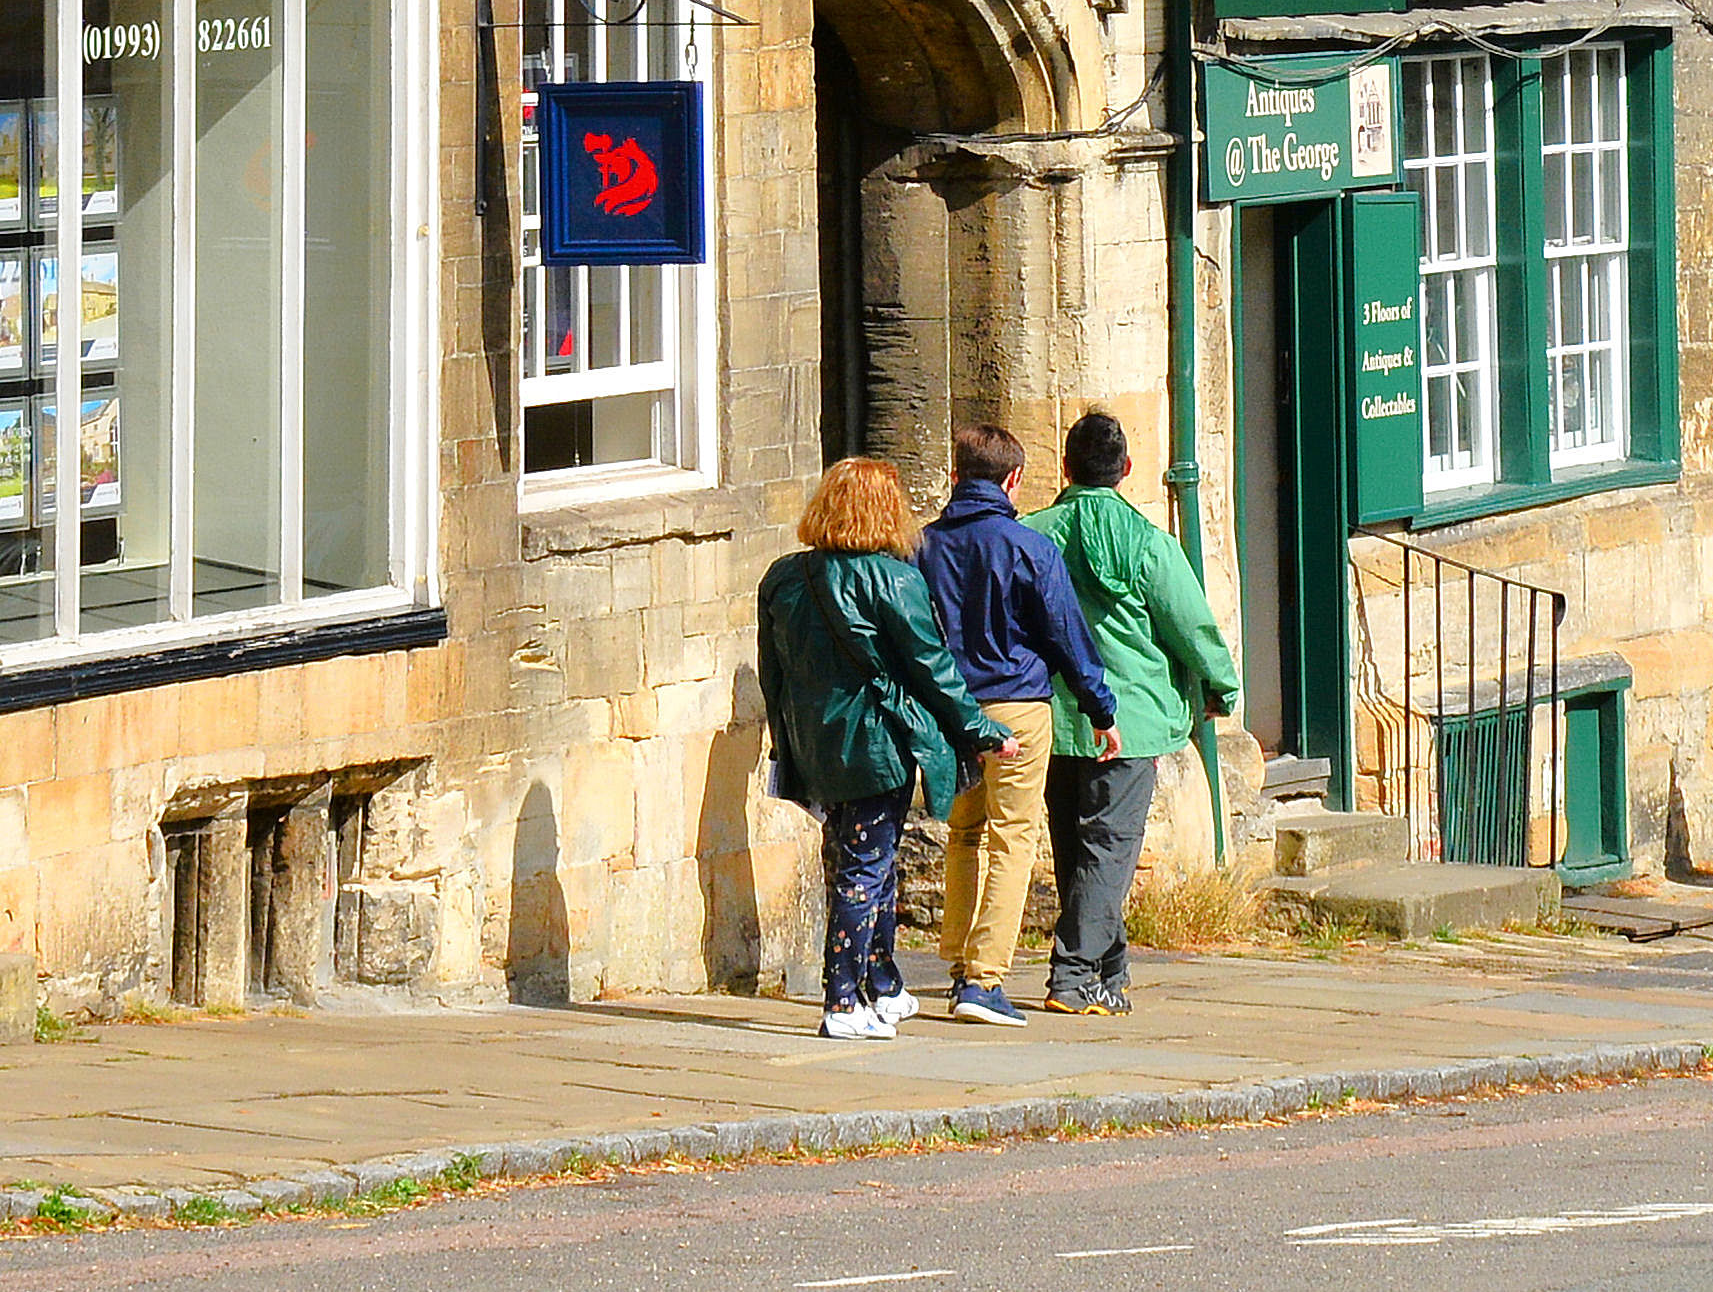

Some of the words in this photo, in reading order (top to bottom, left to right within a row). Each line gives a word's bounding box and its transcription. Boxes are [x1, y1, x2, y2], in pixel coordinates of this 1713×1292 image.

[83, 20, 161, 64] (01993)
[198, 16, 272, 52] 822661
[1245, 79, 1315, 127] Antiques
[1225, 137, 1245, 187] @
[1247, 134, 1281, 174] The
[1283, 132, 1339, 181] George
[1363, 303, 1369, 325] 3
[1372, 300, 1400, 323] Floors
[1401, 297, 1412, 320] of
[1362, 349, 1402, 376] Antiques
[1404, 346, 1414, 366] &
[1362, 392, 1416, 420] Collectables
